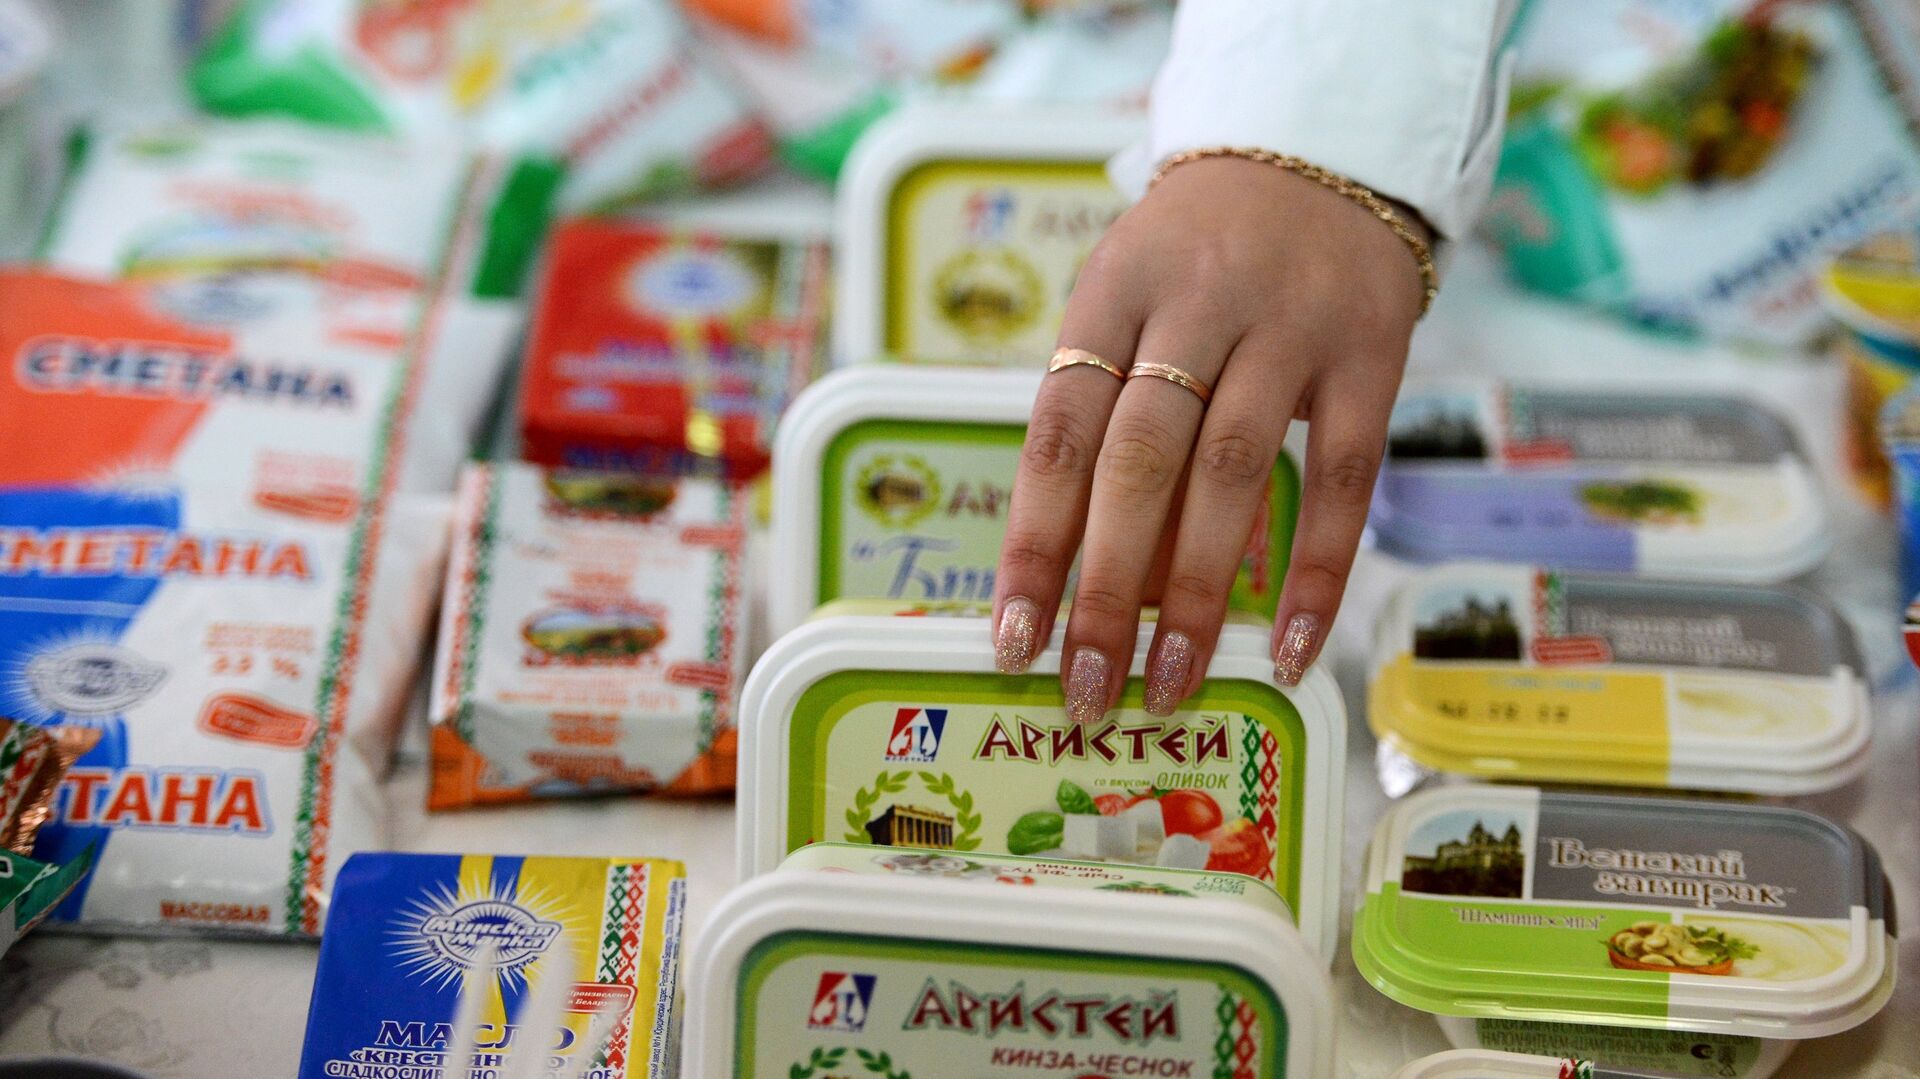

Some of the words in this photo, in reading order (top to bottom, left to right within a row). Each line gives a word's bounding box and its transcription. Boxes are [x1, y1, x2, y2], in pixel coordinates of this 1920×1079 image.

[20, 338, 356, 408] СМЕТАНА
[974, 712, 1233, 767] АРИСТЕЙ
[47, 772, 268, 829] ТАНА
[1156, 771, 1230, 790] ОЛИВОК
[902, 975, 1182, 1047] АРИСТЕЙ
[991, 1047, 1194, 1079] КИНЗА-ЧЕСНОК
